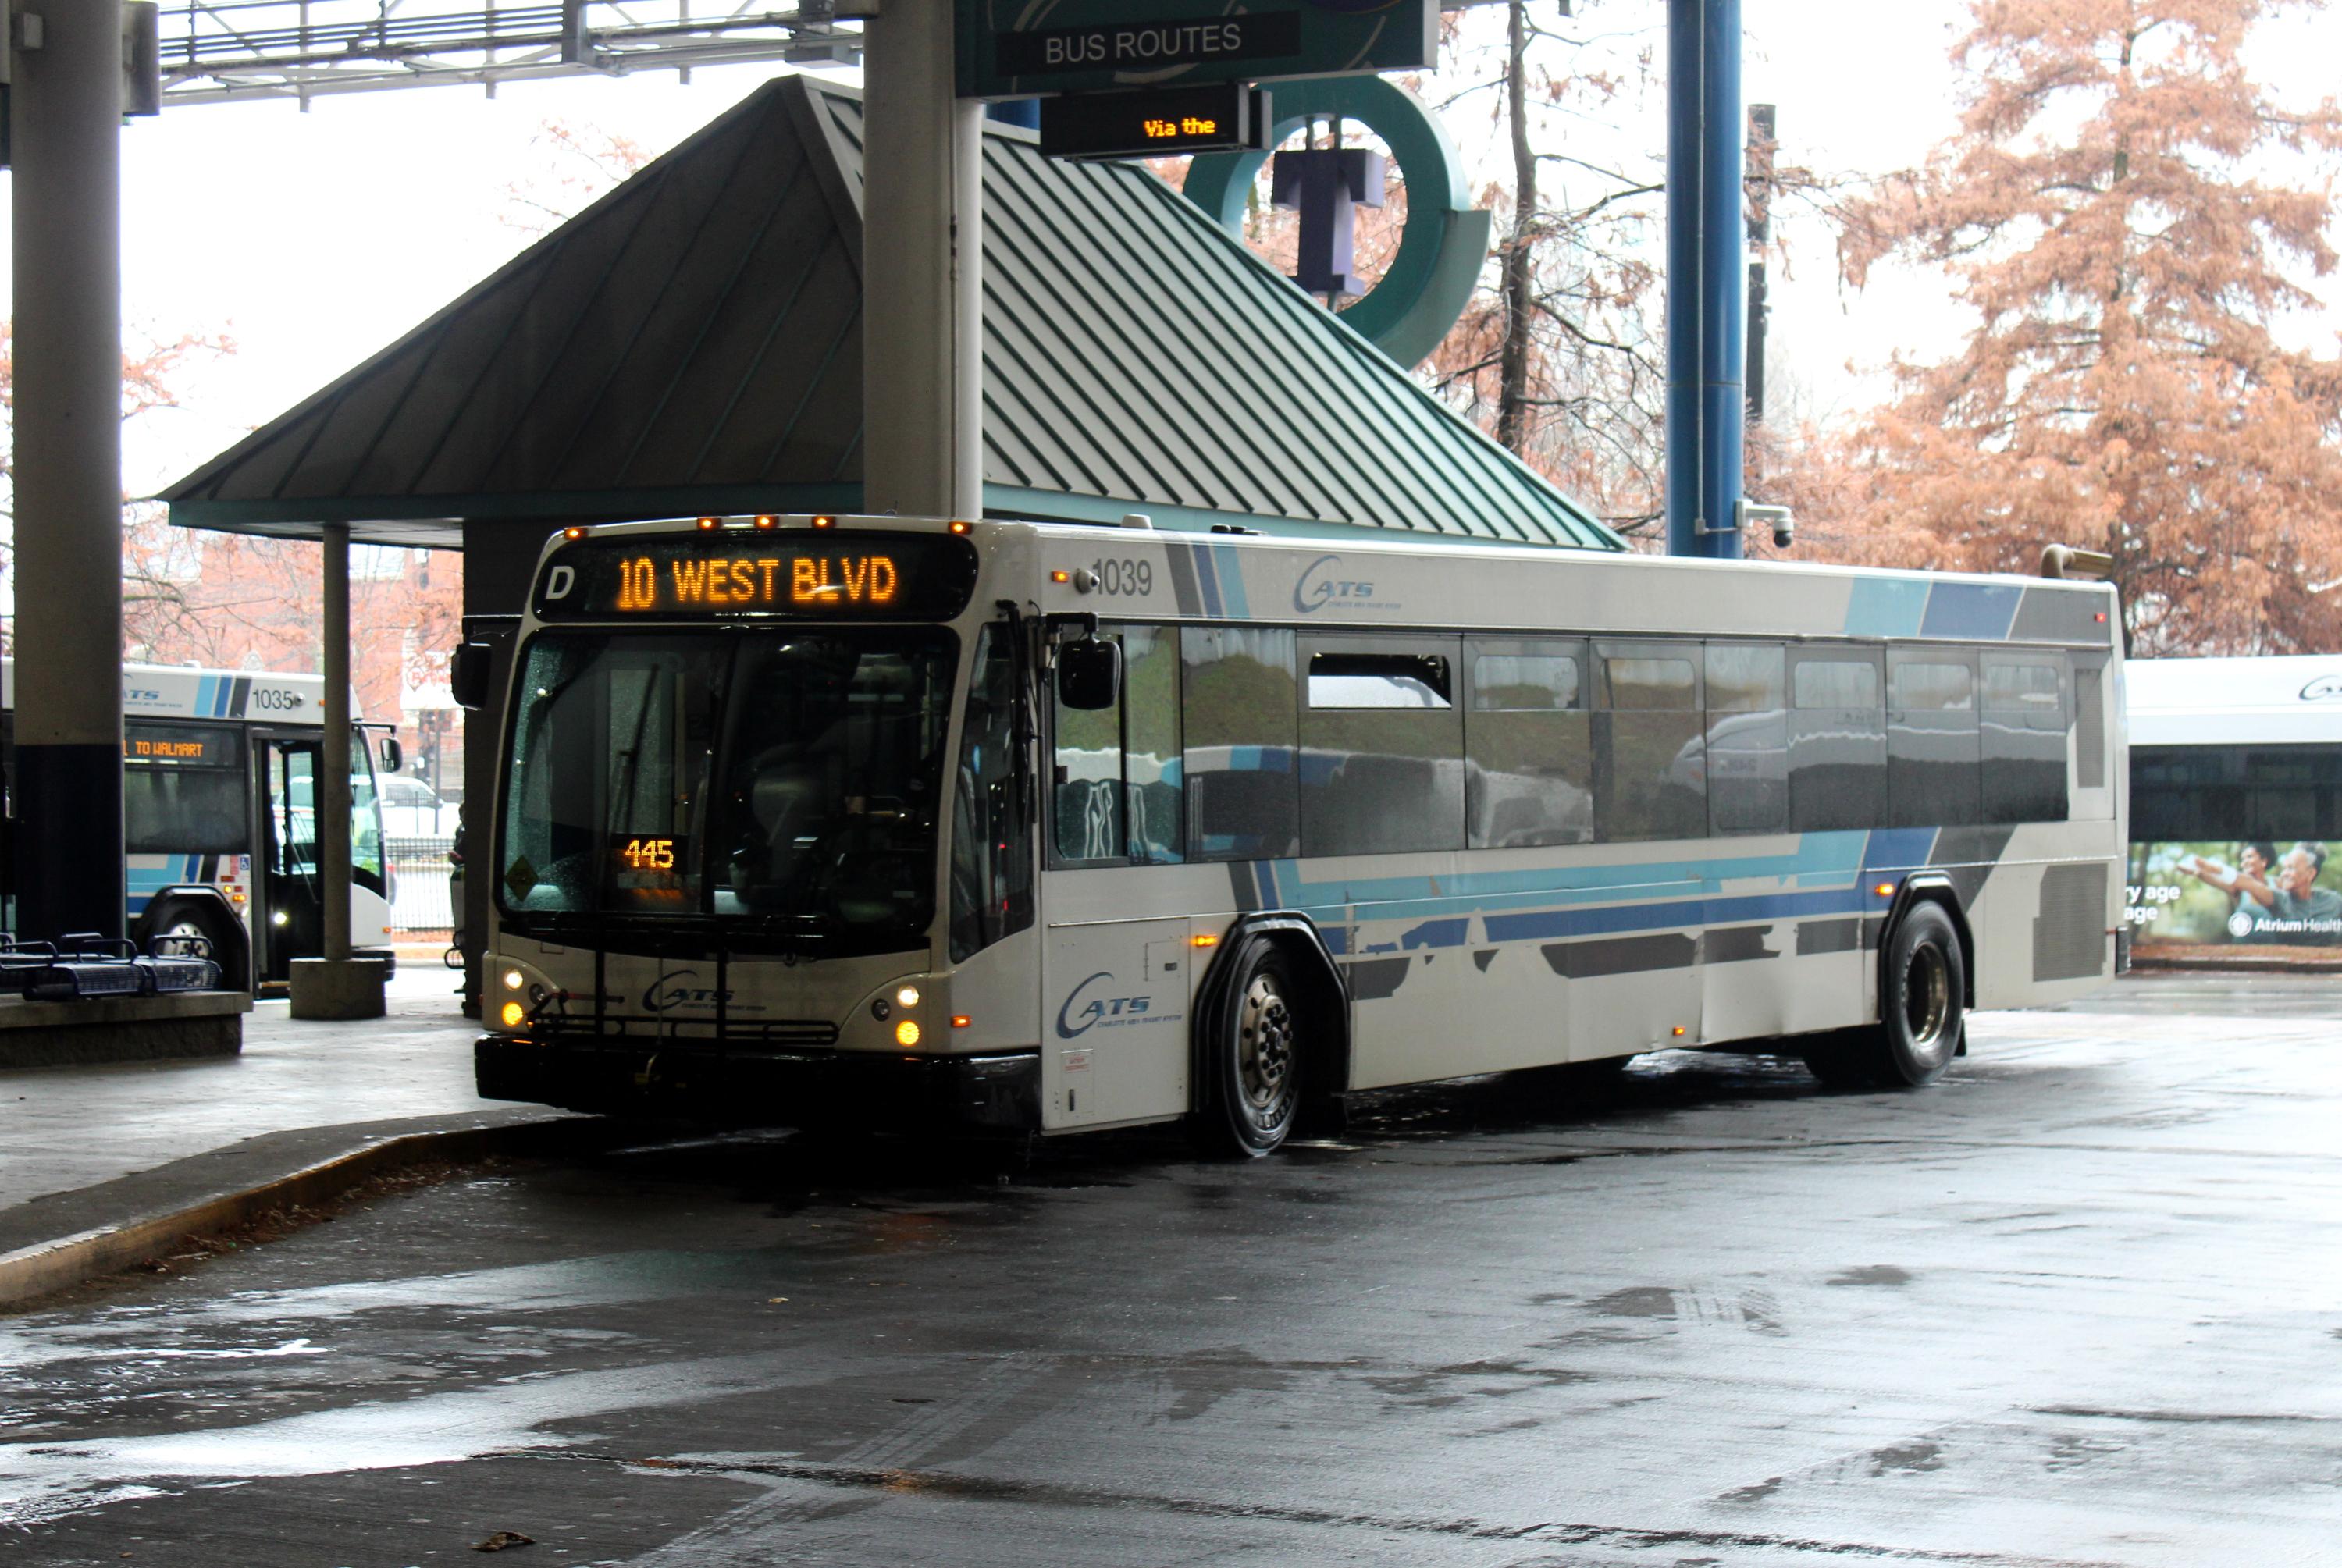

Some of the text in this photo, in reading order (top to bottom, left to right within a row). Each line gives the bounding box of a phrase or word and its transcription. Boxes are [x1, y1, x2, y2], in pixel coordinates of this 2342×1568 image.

[1046, 23, 1241, 64] BUS ROUTES
[1144, 117, 1216, 137] Via the
[546, 566, 575, 599] D
[619, 556, 896, 608] 10 WEST BLVD
[1092, 558, 1152, 596] 1039
[1294, 554, 1375, 613] CATS
[252, 688, 294, 710] 1035
[135, 741, 151, 755] TO
[153, 741, 204, 756] WALMART
[625, 839, 674, 868] 445
[2144, 885, 2181, 905] age
[2255, 916, 2342, 933] Atrium Health
[642, 969, 735, 1012] CATS
[1056, 971, 1151, 1039] CATS
